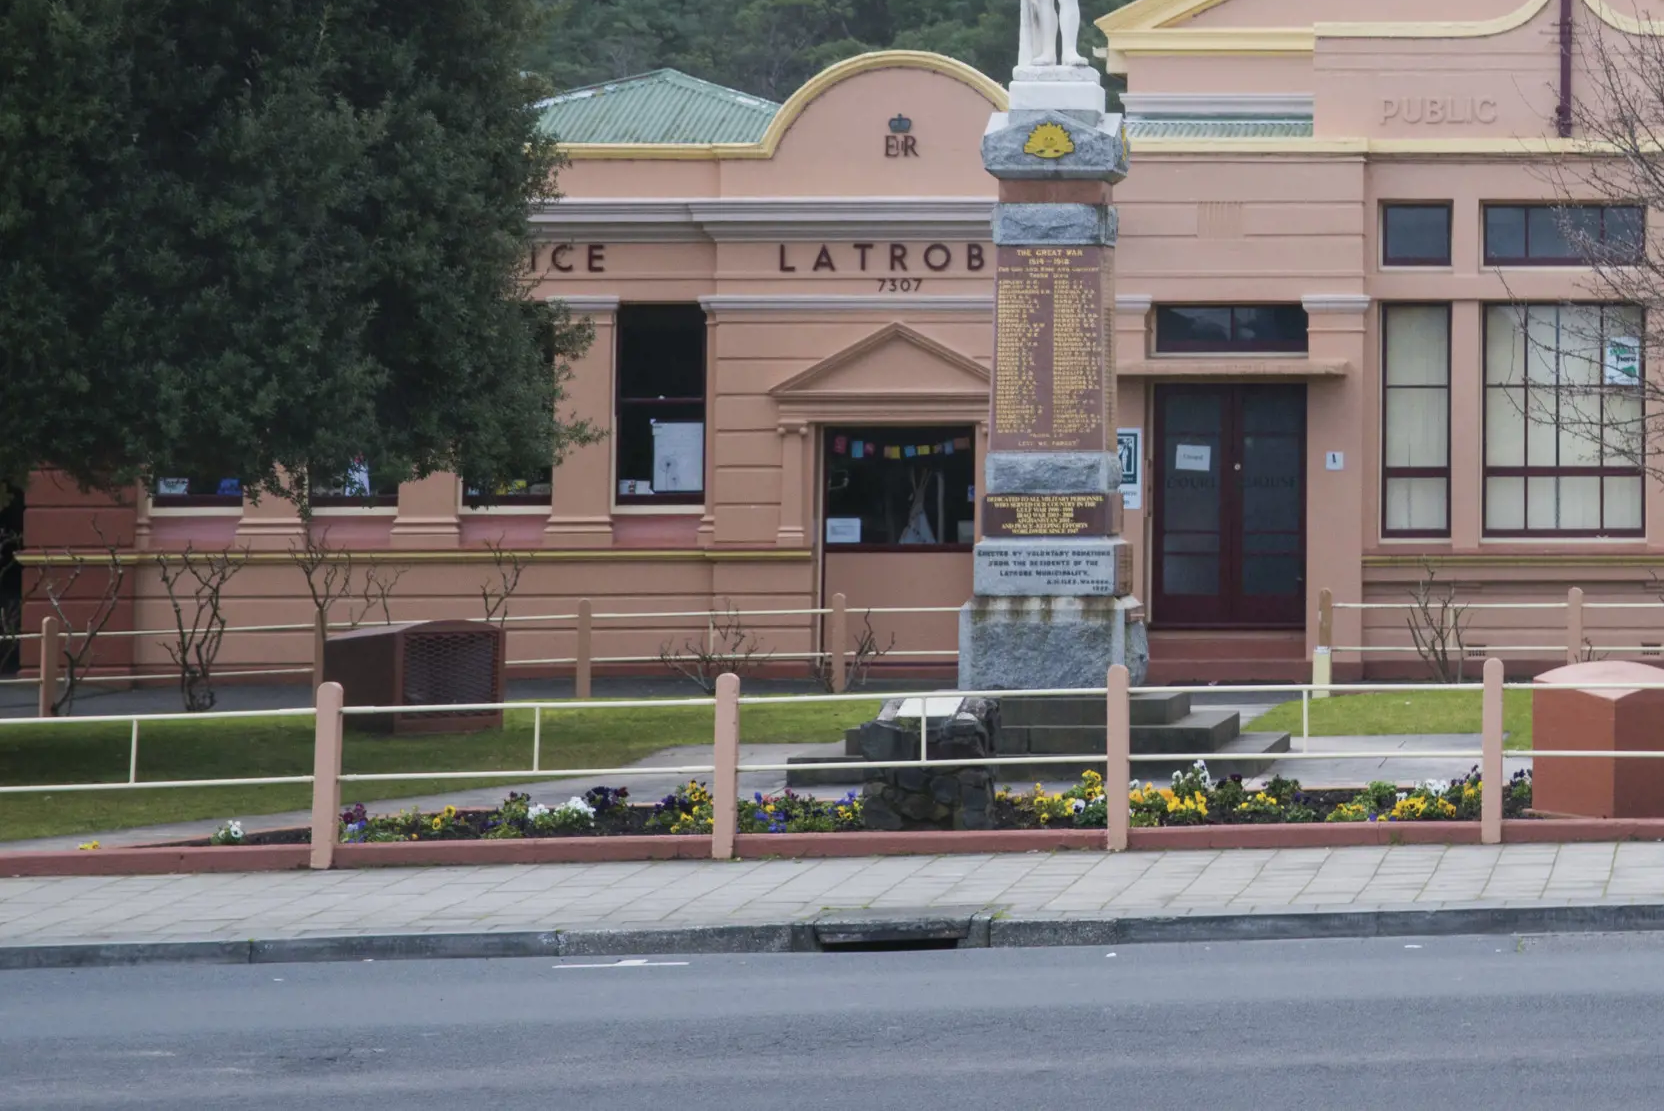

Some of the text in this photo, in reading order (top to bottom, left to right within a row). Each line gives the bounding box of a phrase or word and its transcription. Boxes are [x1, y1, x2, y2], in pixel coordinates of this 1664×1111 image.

[1379, 97, 1497, 126] PUBLIC
[531, 244, 605, 273] ICE
[778, 243, 986, 272] LATROB
[877, 278, 923, 293] 7307
